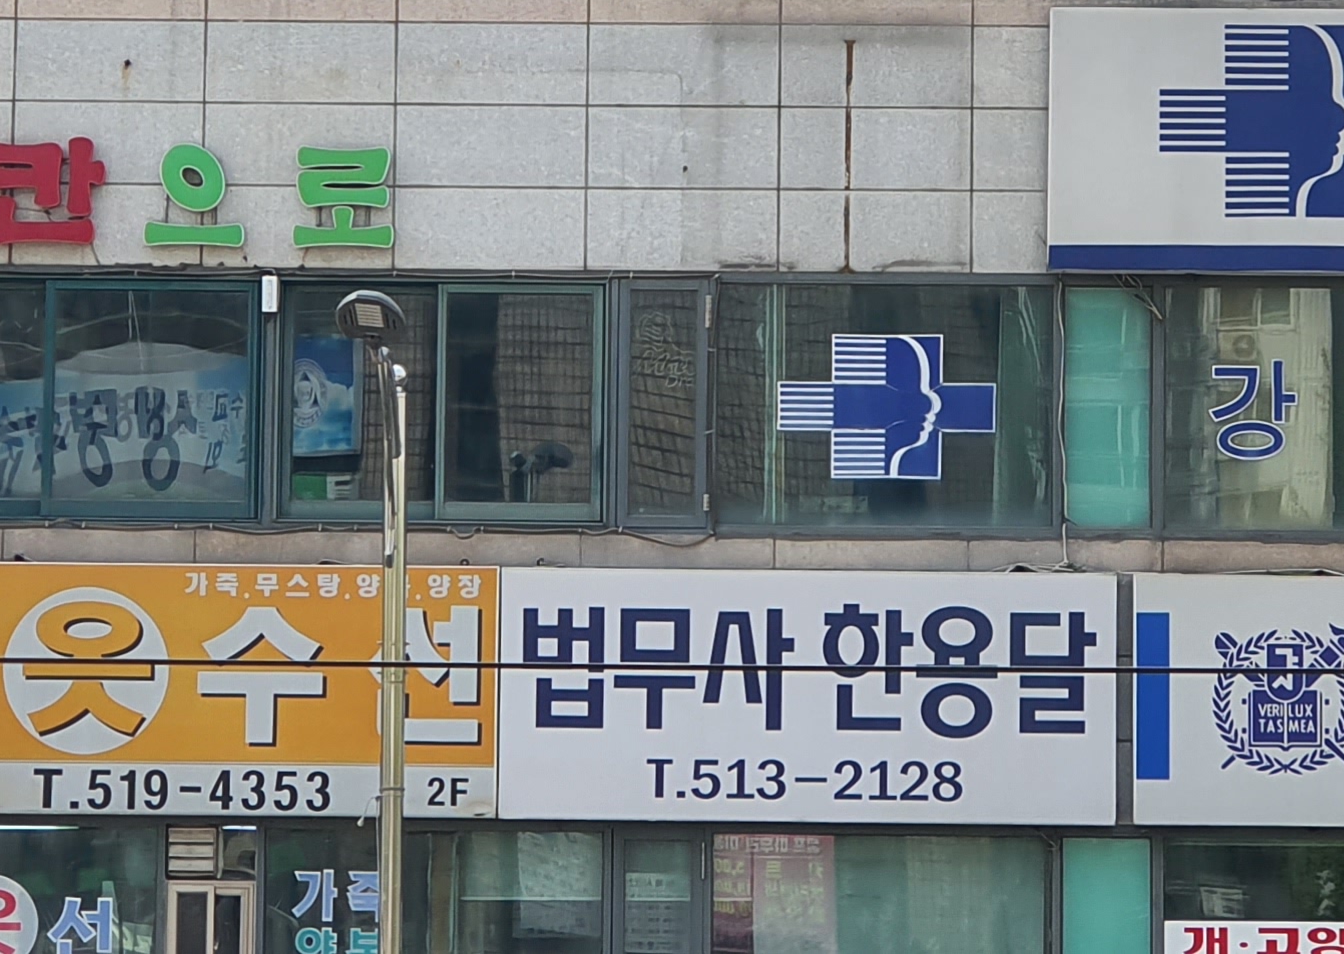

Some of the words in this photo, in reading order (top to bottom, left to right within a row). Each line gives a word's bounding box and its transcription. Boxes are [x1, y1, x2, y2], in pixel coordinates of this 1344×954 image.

[522, 607, 796, 731] 법무사
[822, 603, 1098, 740] 한용달
[1288, 703, 1314, 718] LUX
[1288, 719, 1316, 734] MEA
[426, 777, 471, 808] 2F
[645, 758, 964, 803] T.513-2128
